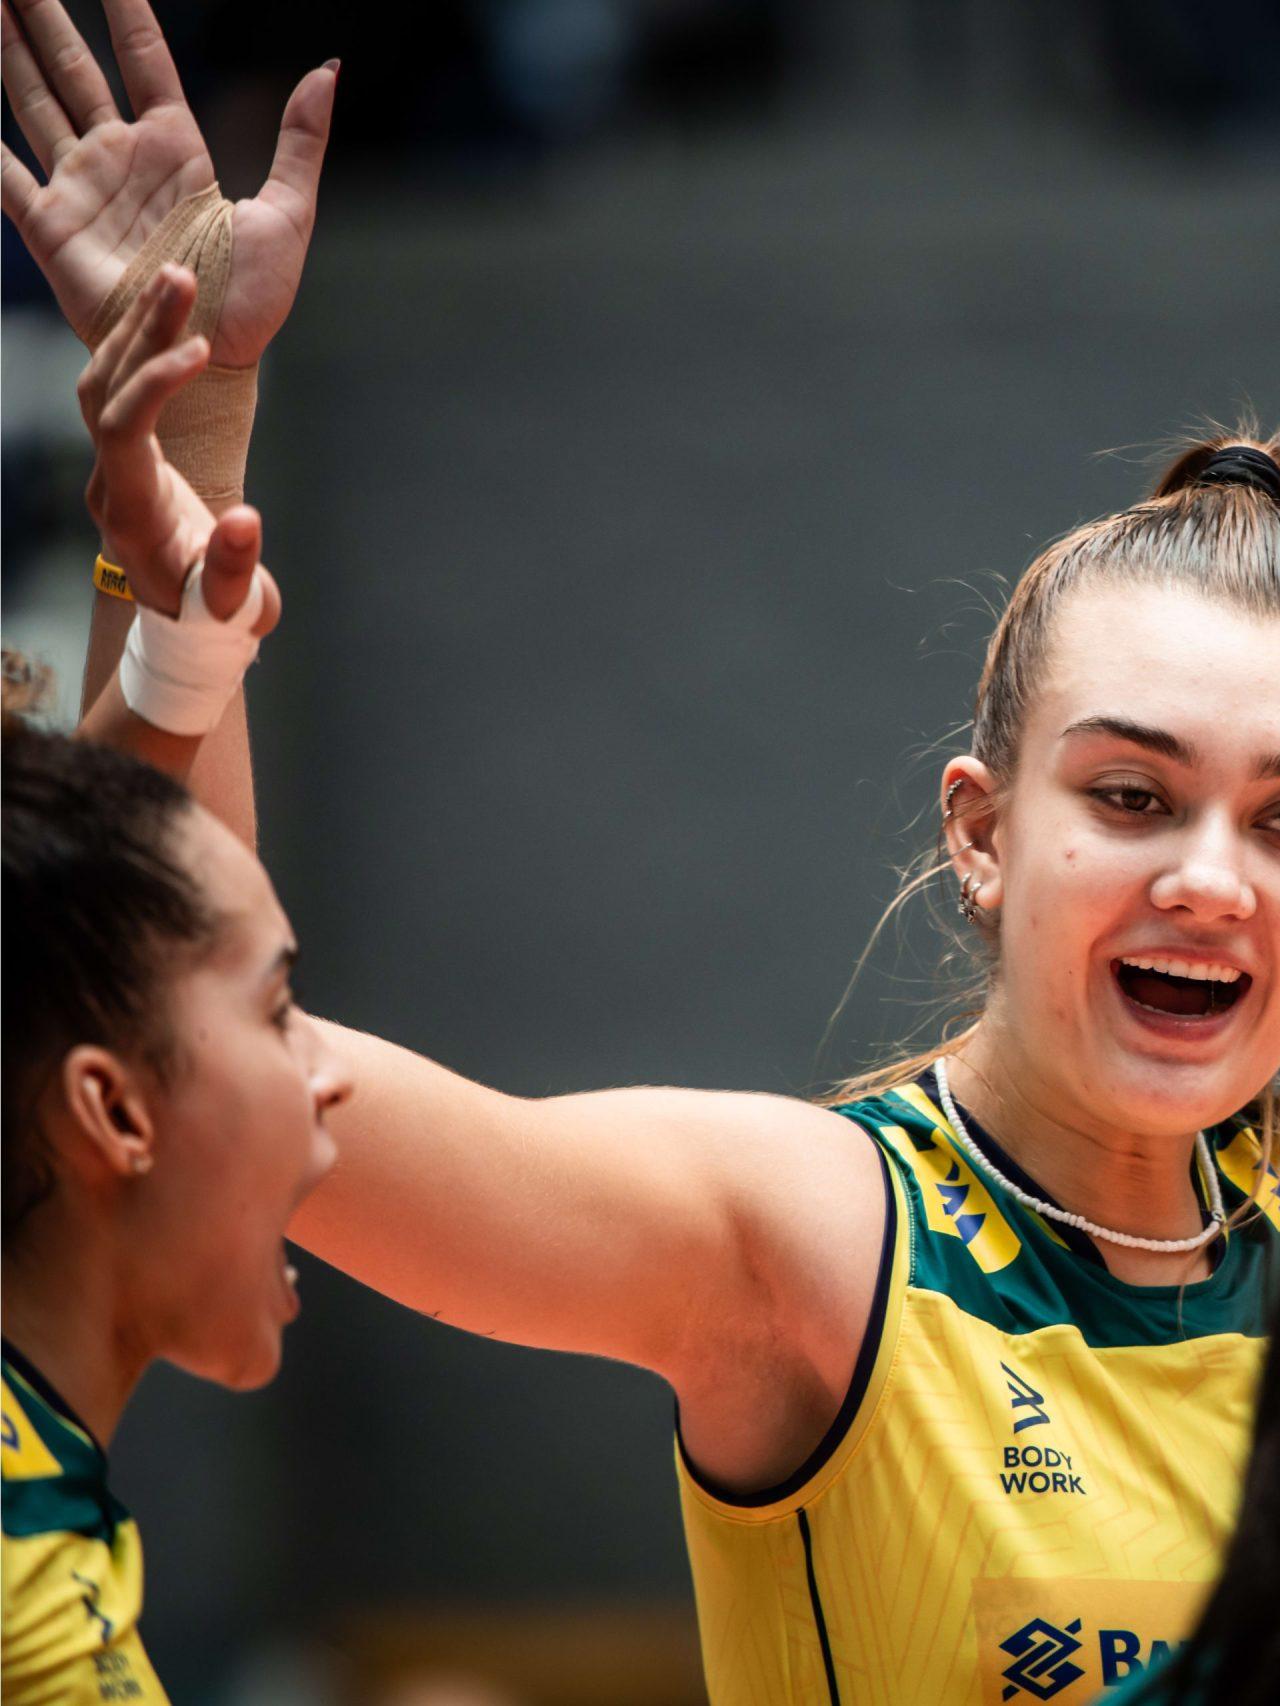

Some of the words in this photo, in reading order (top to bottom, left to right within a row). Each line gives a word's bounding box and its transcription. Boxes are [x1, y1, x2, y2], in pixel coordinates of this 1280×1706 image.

[1003, 1446, 1072, 1470] BODY
[999, 1471, 1086, 1495] WORK
[1098, 1630, 1186, 1687] BA
